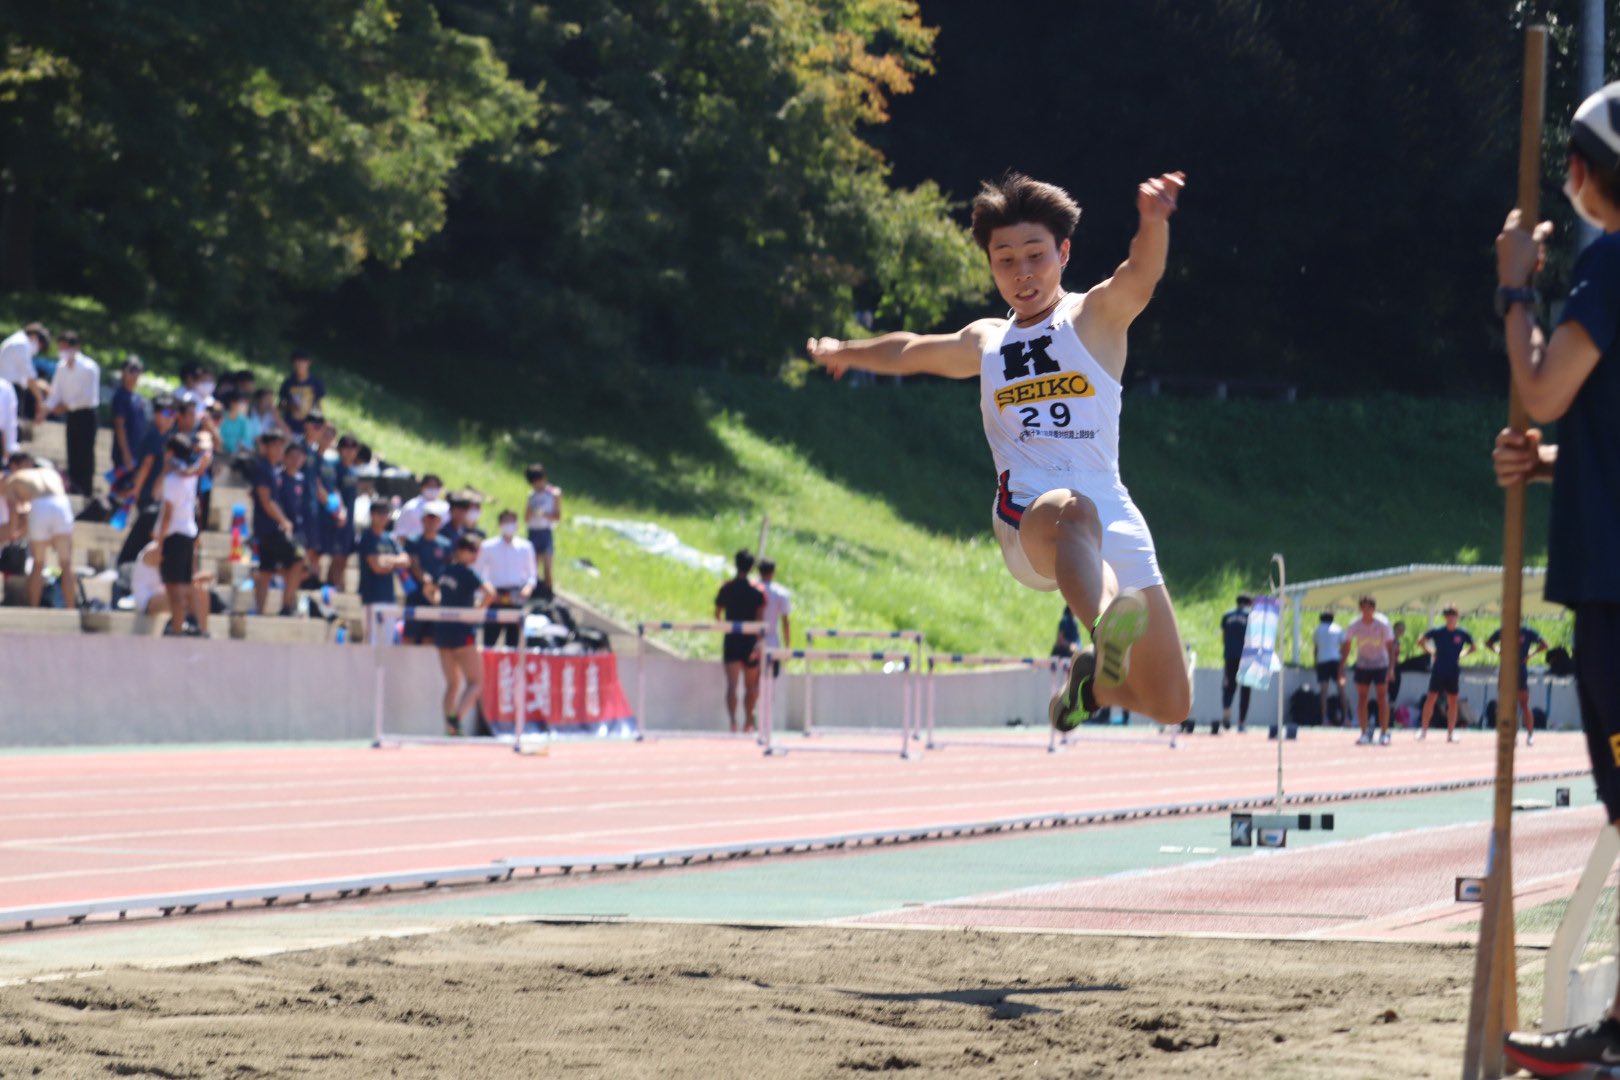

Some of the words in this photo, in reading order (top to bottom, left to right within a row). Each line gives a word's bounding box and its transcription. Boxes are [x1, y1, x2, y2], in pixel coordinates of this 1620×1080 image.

[1000, 335, 1061, 381] K
[997, 375, 1088, 408] SEIKO
[1019, 402, 1071, 428] 29
